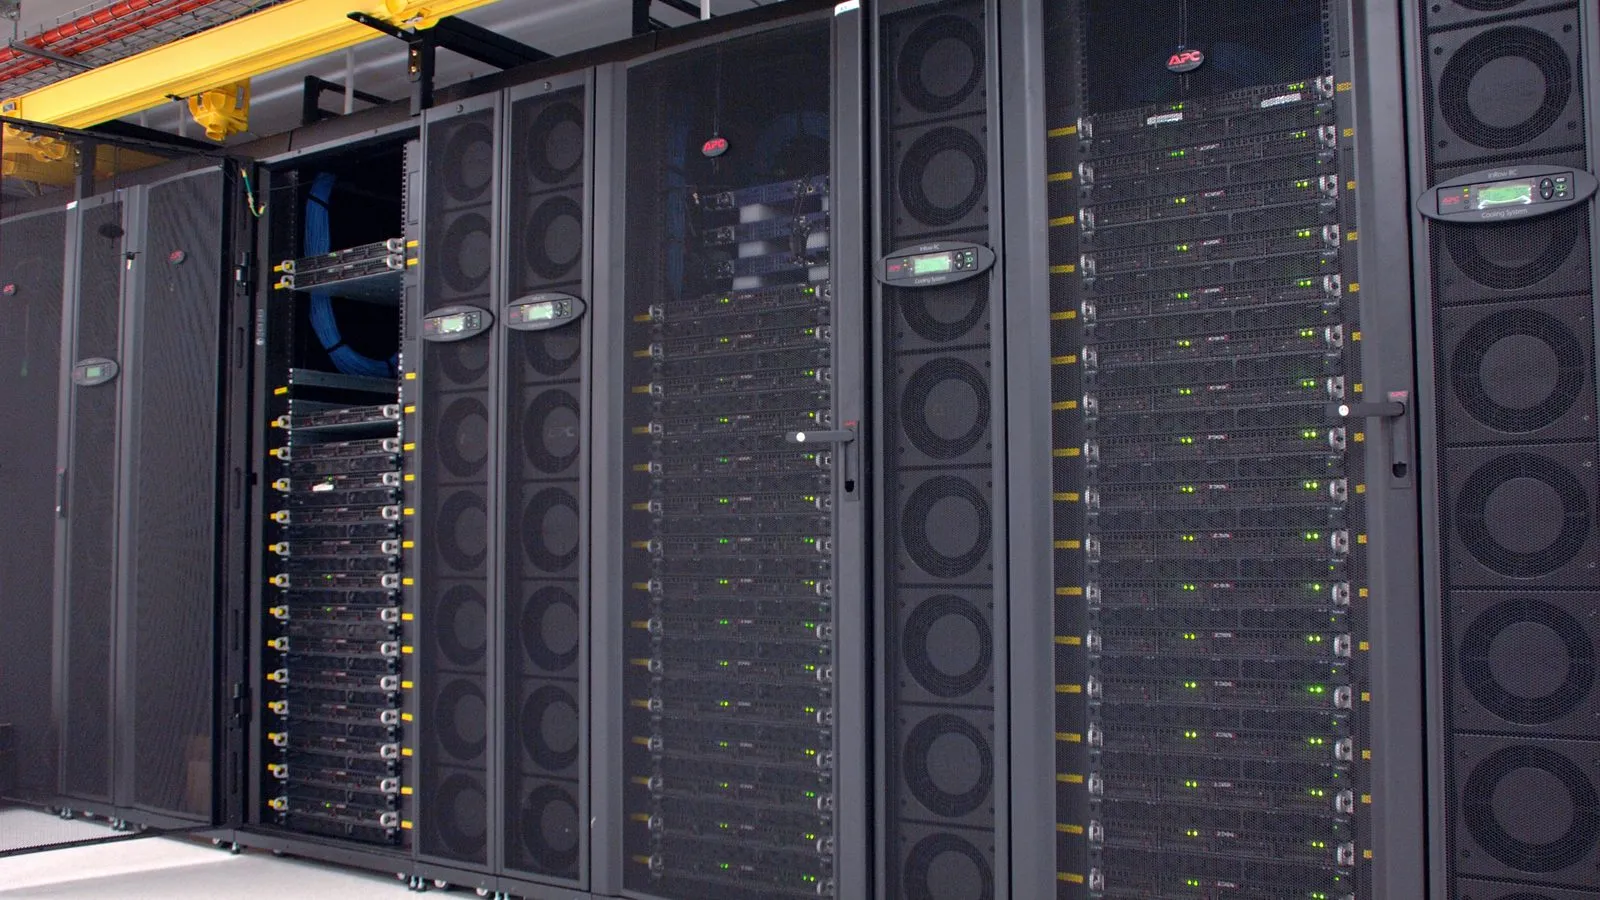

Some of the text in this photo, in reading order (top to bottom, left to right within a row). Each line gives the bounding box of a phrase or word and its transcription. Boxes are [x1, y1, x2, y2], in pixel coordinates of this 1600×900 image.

[1168, 50, 1200, 65] APC
[703, 138, 725, 151] APC
[1481, 208, 1528, 219] Cooling System
